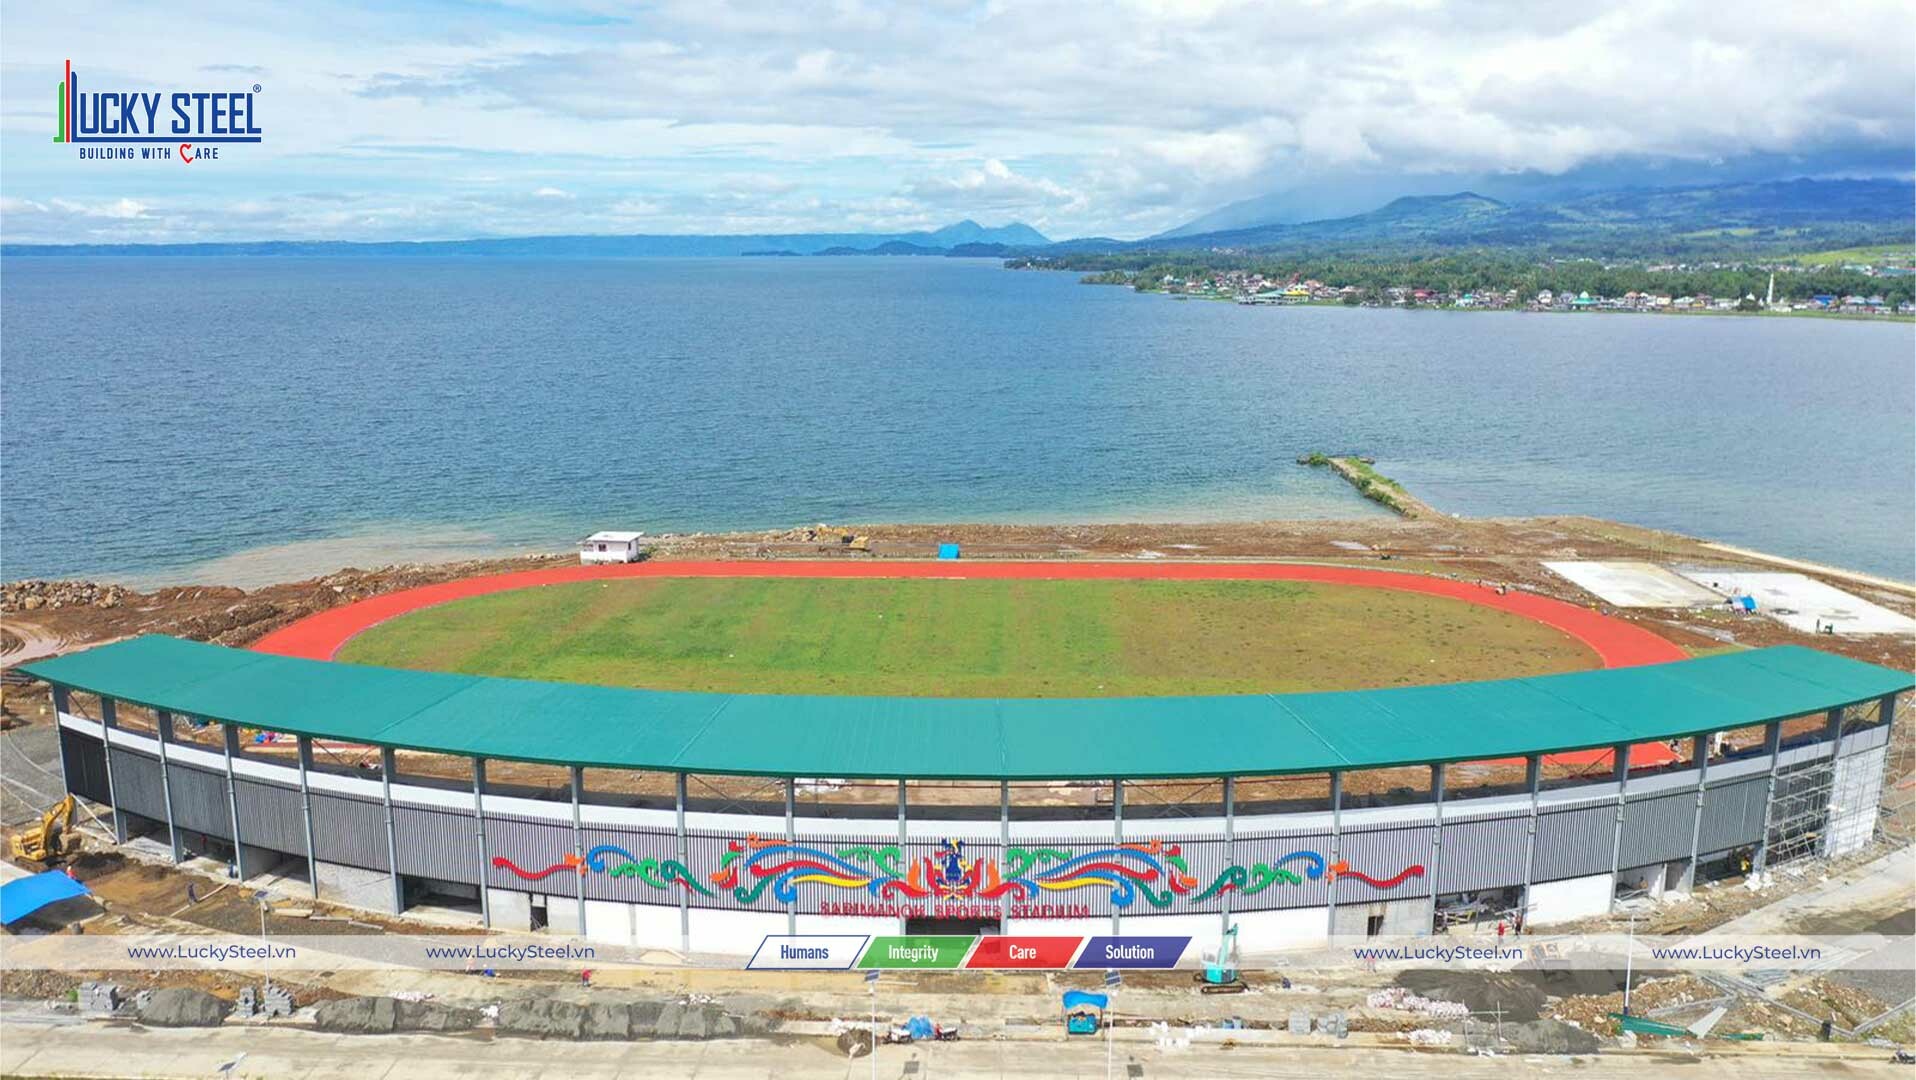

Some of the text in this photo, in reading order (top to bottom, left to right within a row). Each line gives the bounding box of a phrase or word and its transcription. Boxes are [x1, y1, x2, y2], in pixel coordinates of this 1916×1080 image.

[820, 902, 1089, 920] SARIMANOK SPORTS STADIUM
